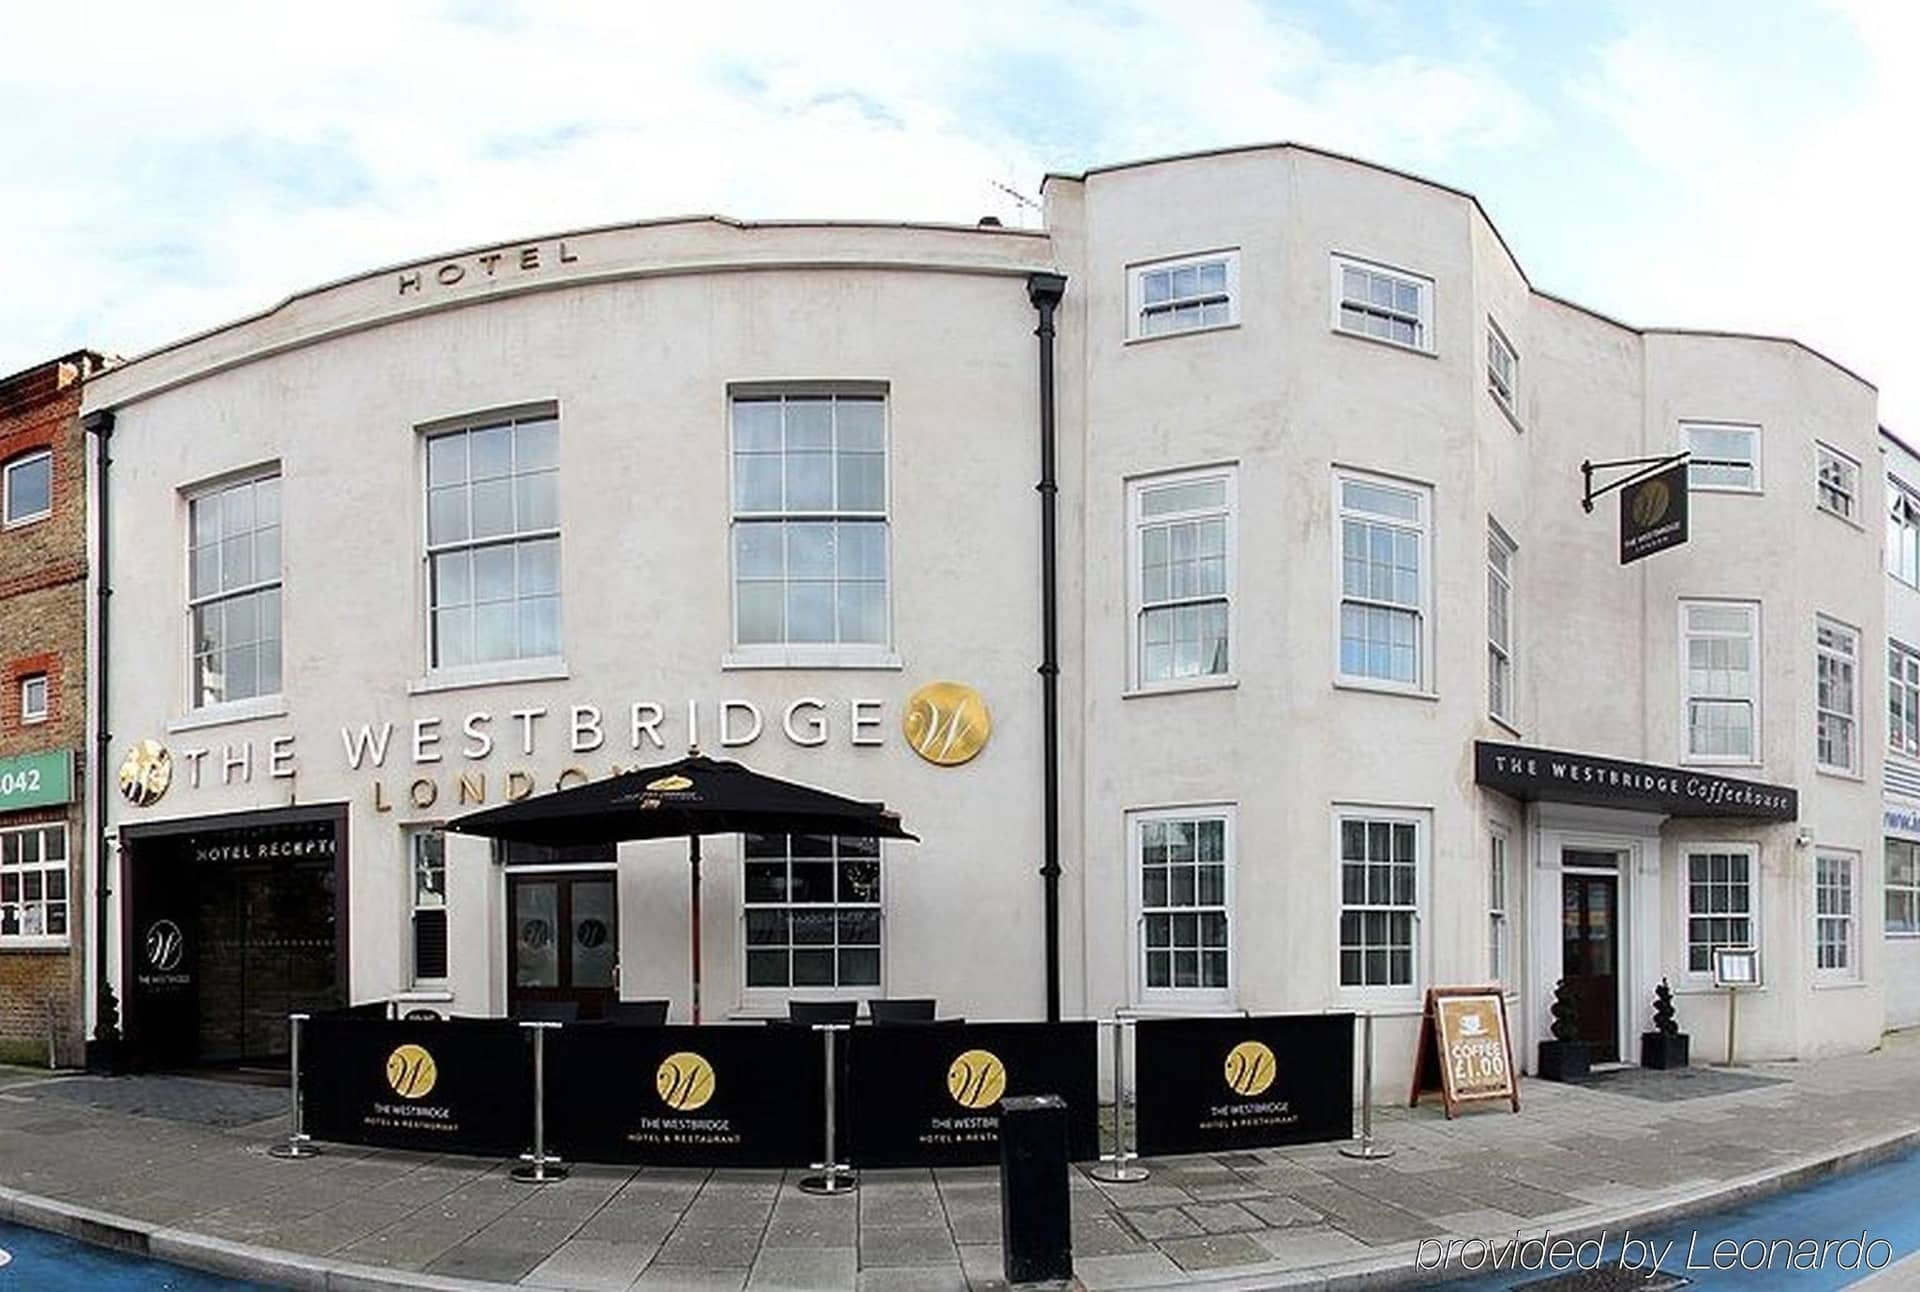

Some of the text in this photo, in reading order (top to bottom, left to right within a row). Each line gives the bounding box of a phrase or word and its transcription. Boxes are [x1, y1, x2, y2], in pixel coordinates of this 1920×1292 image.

[399, 242, 578, 294] HOTEL
[185, 735, 296, 790] THE
[340, 697, 885, 770] WESTBRIDGE
[0, 768, 41, 797] 042
[375, 763, 637, 812] LONDO
[1495, 756, 1788, 809] THE WESTBRIDGE Coffeehouse
[196, 843, 251, 862] HOTEL
[1451, 1041, 1502, 1060] COFFEE
[1455, 1056, 1504, 1079] £1.00
[374, 1102, 449, 1119] THE WESTBRIDGE
[1211, 1102, 1289, 1116] THE WESTBRIDGE
[640, 1117, 729, 1131] THE WESTBRIDGE
[932, 1118, 952, 1129] THE
